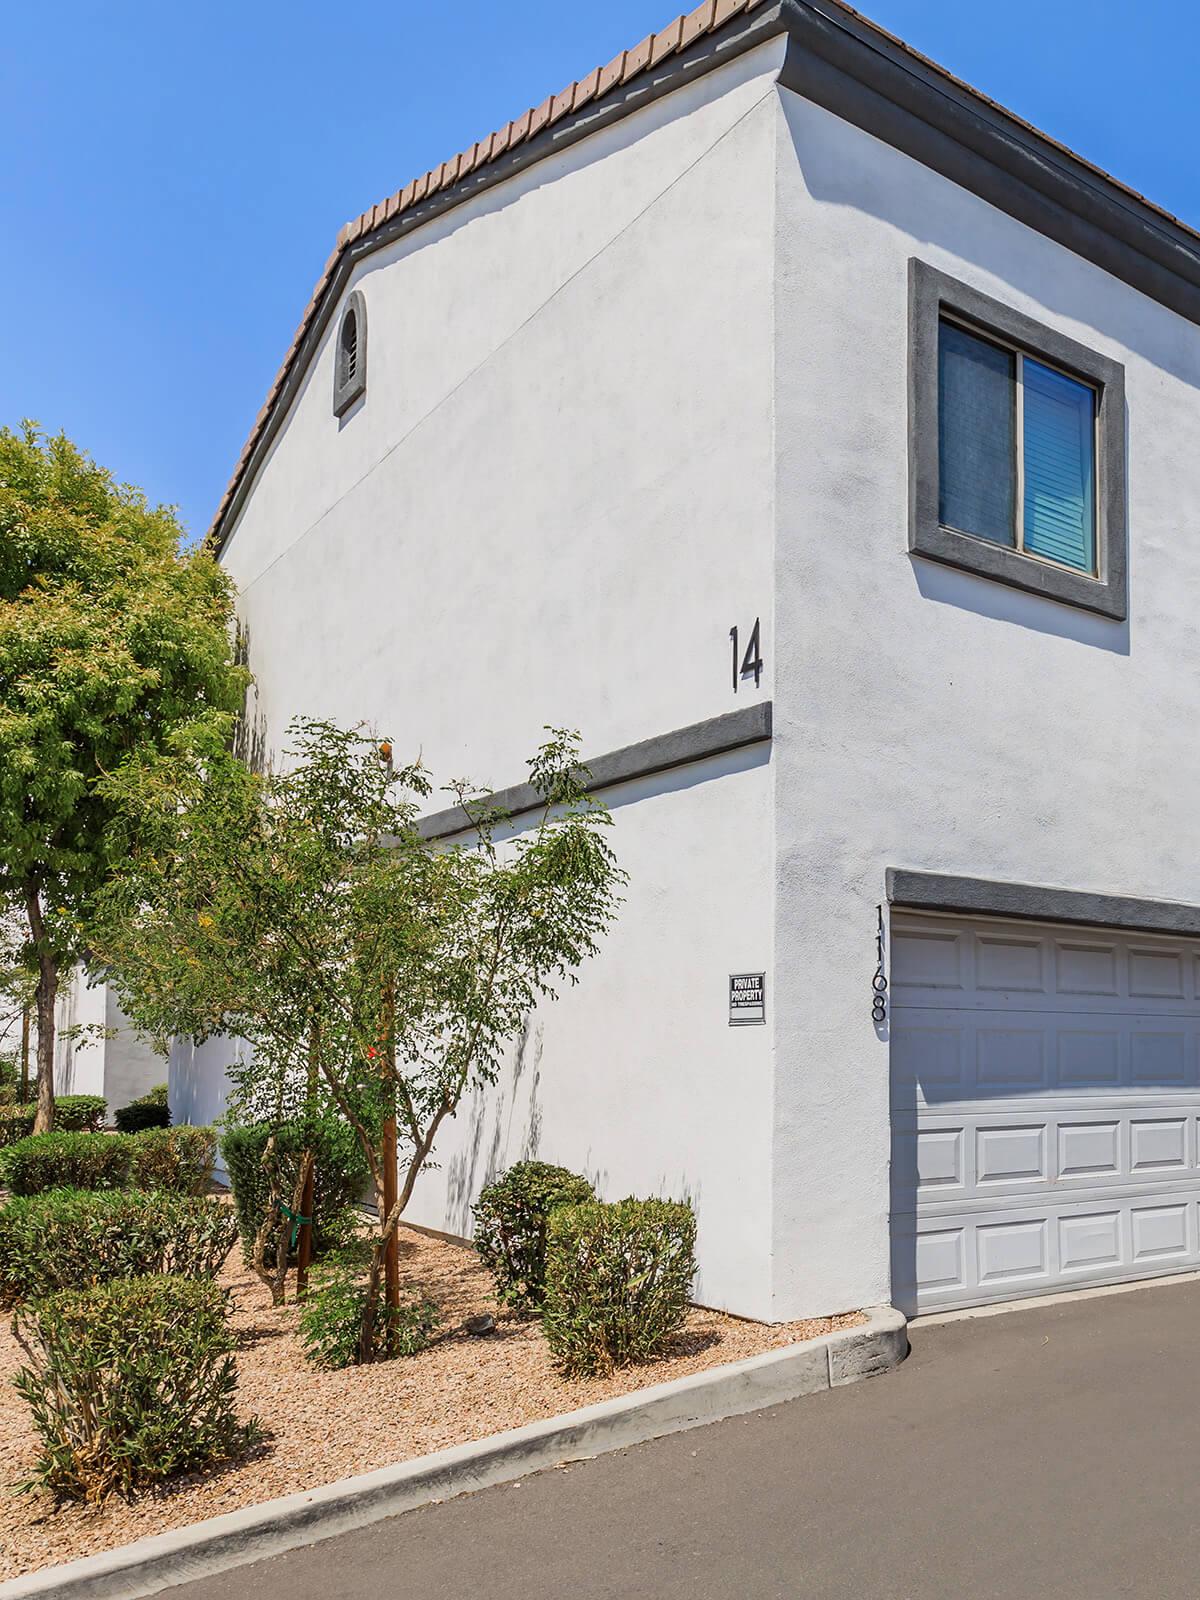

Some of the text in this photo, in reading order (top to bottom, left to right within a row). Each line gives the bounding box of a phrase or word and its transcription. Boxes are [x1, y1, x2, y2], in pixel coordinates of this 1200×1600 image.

[729, 616, 763, 693] 14
[734, 977, 760, 990] PRIVATE
[871, 904, 888, 1022] 1168
[731, 989, 763, 1001] PROPERTY
